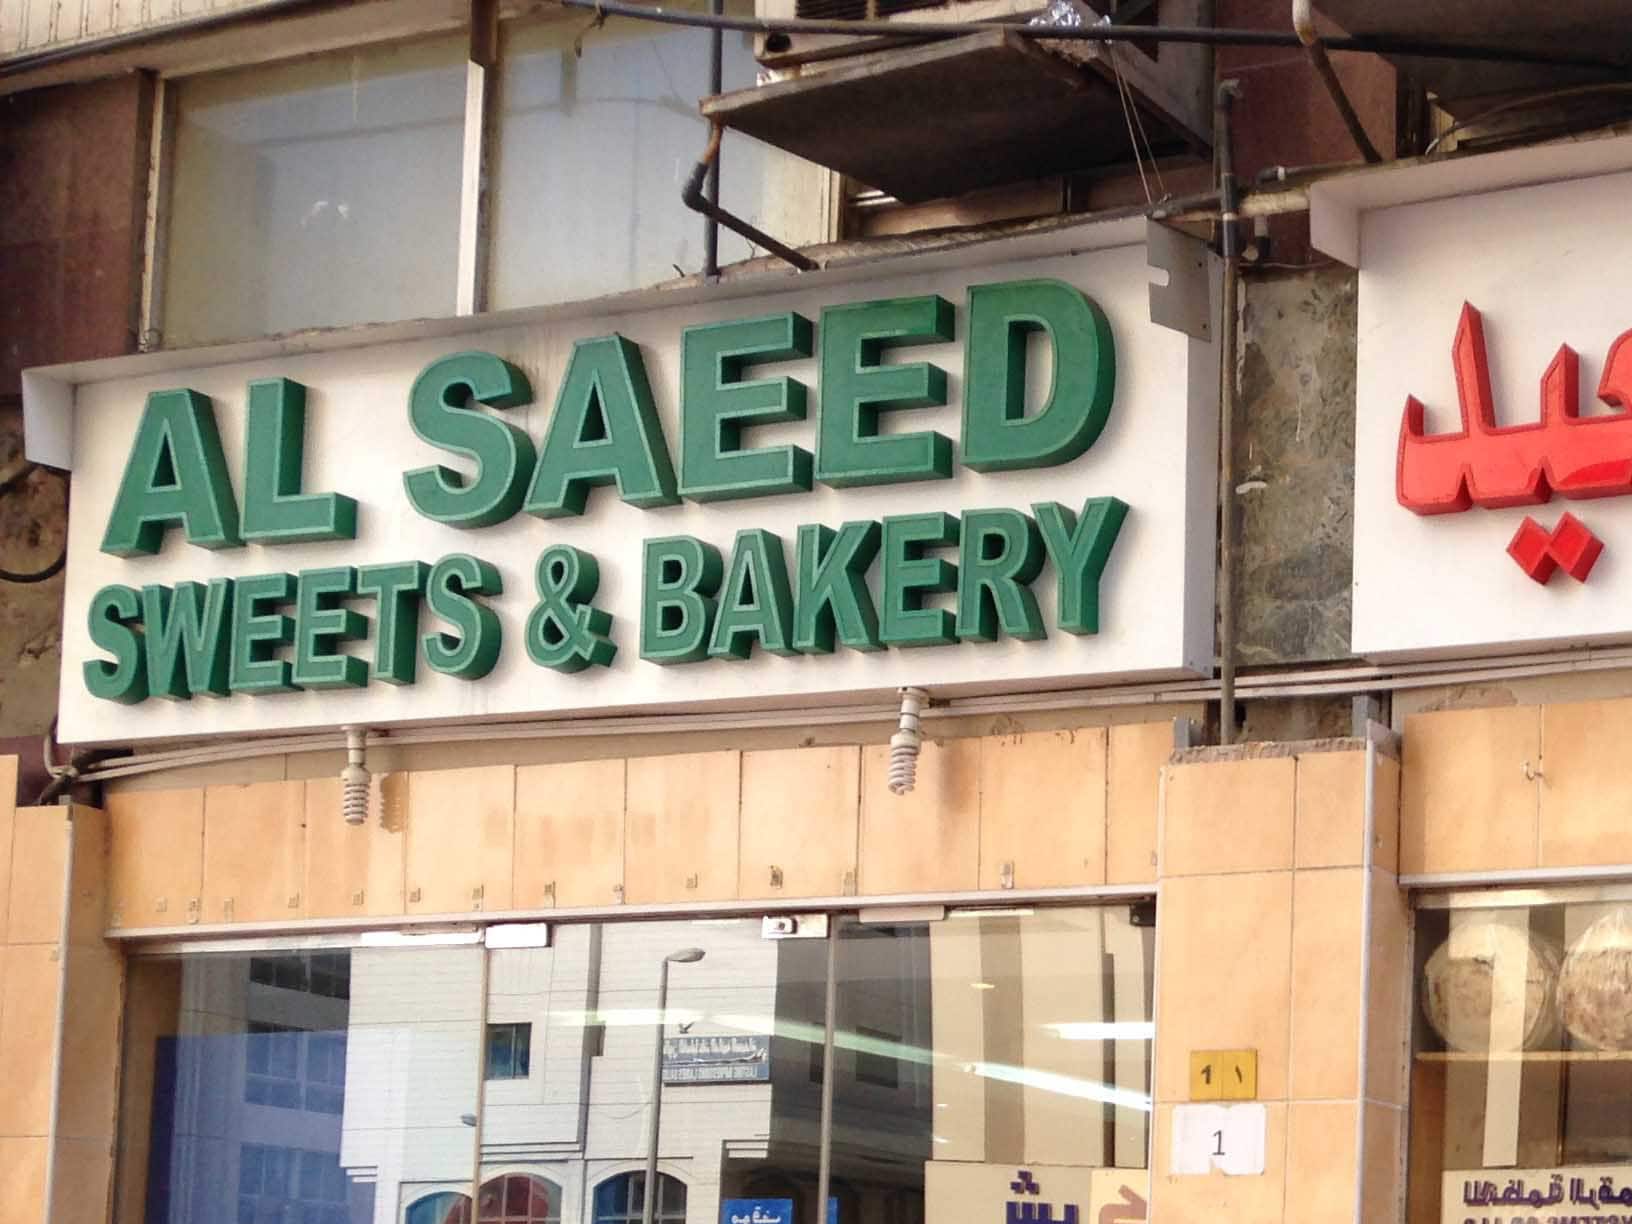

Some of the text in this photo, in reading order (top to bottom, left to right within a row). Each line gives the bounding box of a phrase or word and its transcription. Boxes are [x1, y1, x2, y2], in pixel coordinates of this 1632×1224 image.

[100, 276, 1117, 558] AL SAEED
[83, 494, 1130, 705] SWEETS & BAKERY
[1212, 1129, 1226, 1156] 1
